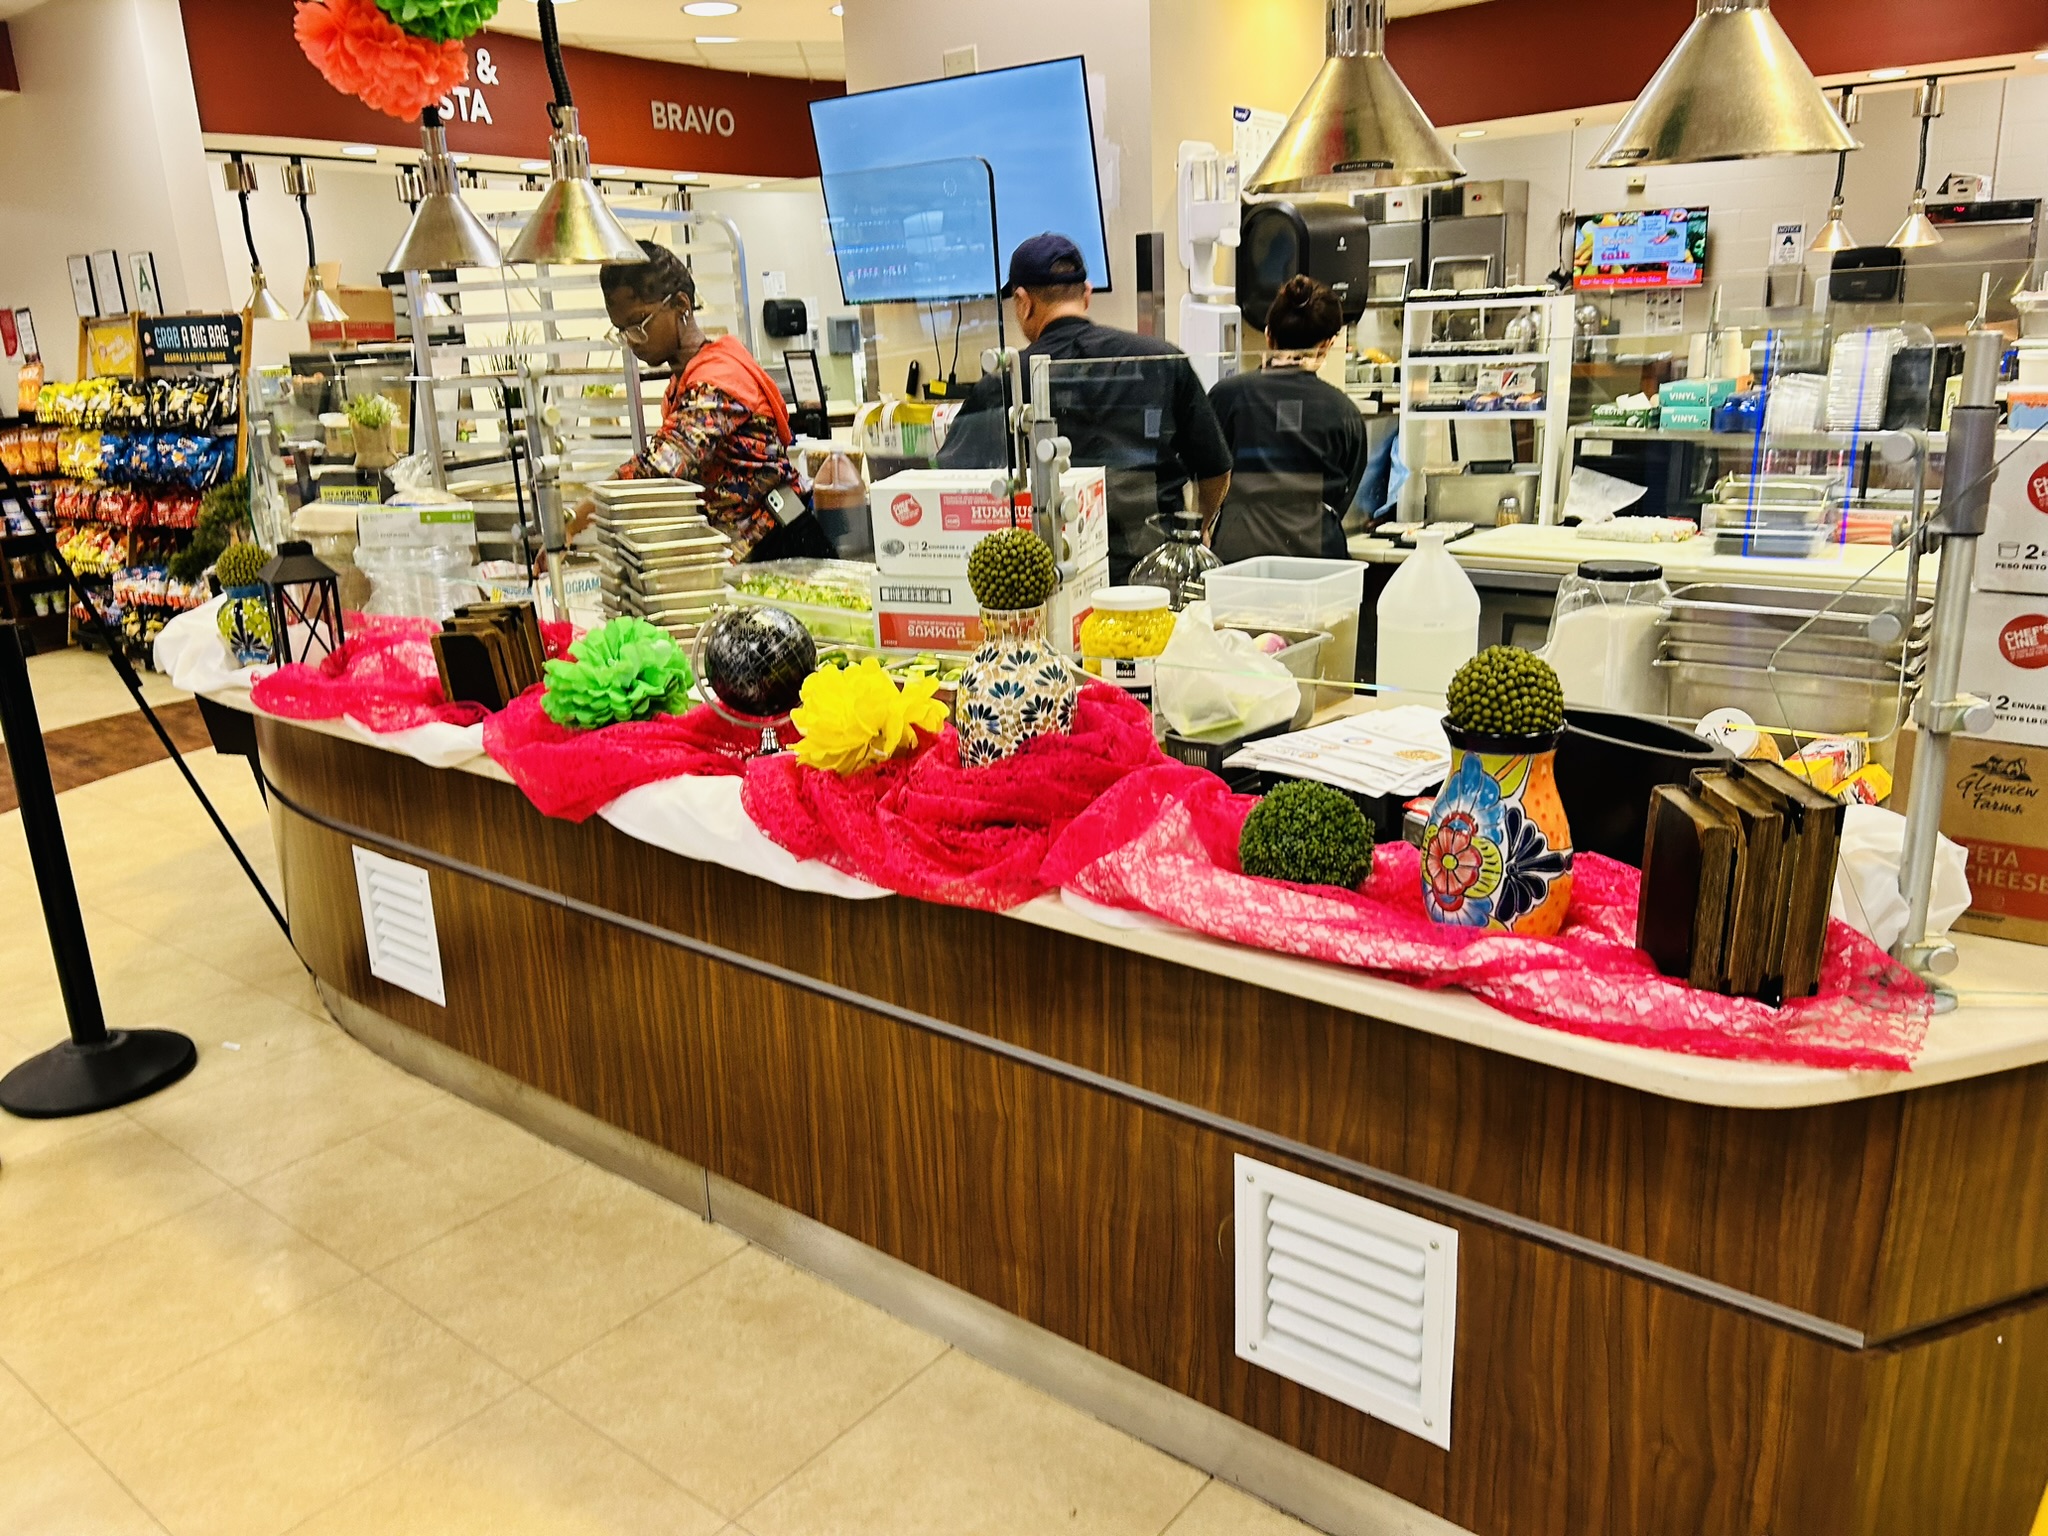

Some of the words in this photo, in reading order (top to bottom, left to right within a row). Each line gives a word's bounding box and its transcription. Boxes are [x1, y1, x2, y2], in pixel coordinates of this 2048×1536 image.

[476, 48, 499, 85] &
[438, 86, 493, 125] STA
[651, 100, 735, 137] BRAVO
[139, 263, 152, 293] A
[154, 327, 180, 348] GRAB
[181, 326, 189, 348] A
[189, 325, 208, 348] BIG
[208, 324, 229, 347] BAG
[1669, 392, 1696, 400] VINYL
[1671, 414, 1698, 423] VINYL
[921, 541, 928, 551] 2
[2025, 544, 2039, 560] 2
[1995, 562, 2019, 570] PESO
[2022, 563, 2047, 571] NETO
[545, 577, 600, 598] MOGRAM
[908, 625, 965, 639] HUMMUS
[2006, 636, 2038, 651] LINE
[1996, 695, 2009, 711] 2
[2012, 702, 2047, 711] ENVASE
[1956, 772, 2039, 799] Glenview
[1973, 791, 2023, 815] Farms
